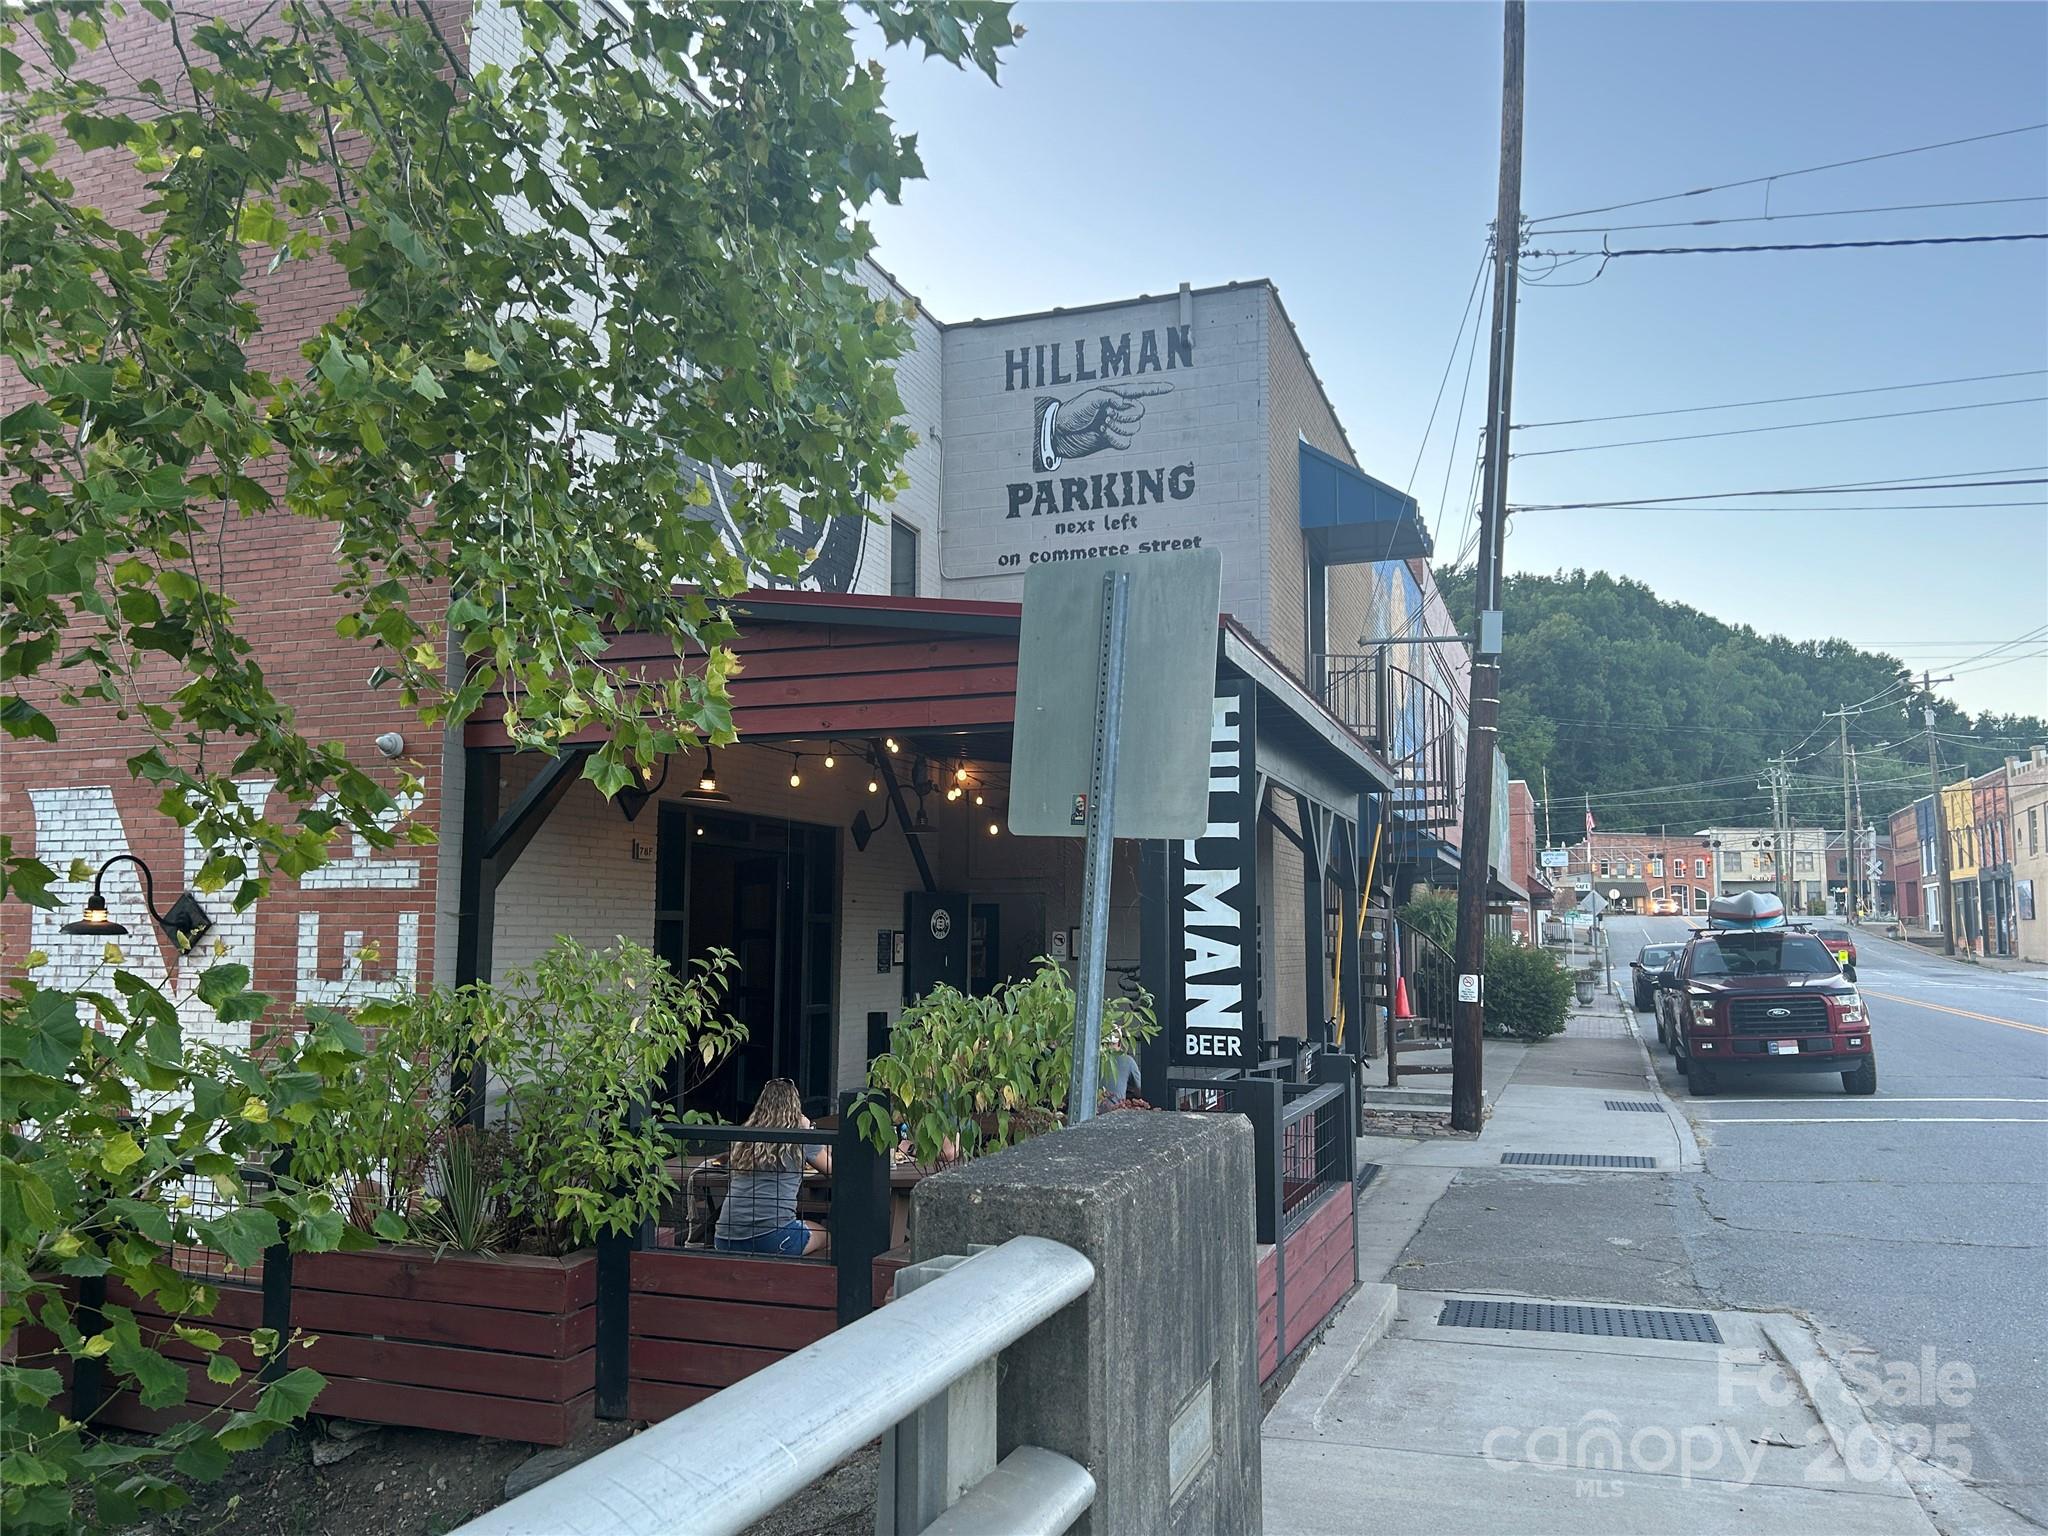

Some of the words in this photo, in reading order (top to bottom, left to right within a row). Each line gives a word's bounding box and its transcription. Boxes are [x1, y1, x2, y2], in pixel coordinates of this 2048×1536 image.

[1005, 325, 1194, 391] HILLMAN
[1006, 461, 1196, 519] PARKING
[1055, 520, 1095, 534] next
[1104, 514, 1138, 530] left
[998, 553, 1020, 566] on
[1029, 543, 1129, 563] commerce
[1139, 536, 1202, 553] street
[1185, 1034, 1243, 1057] BEER
